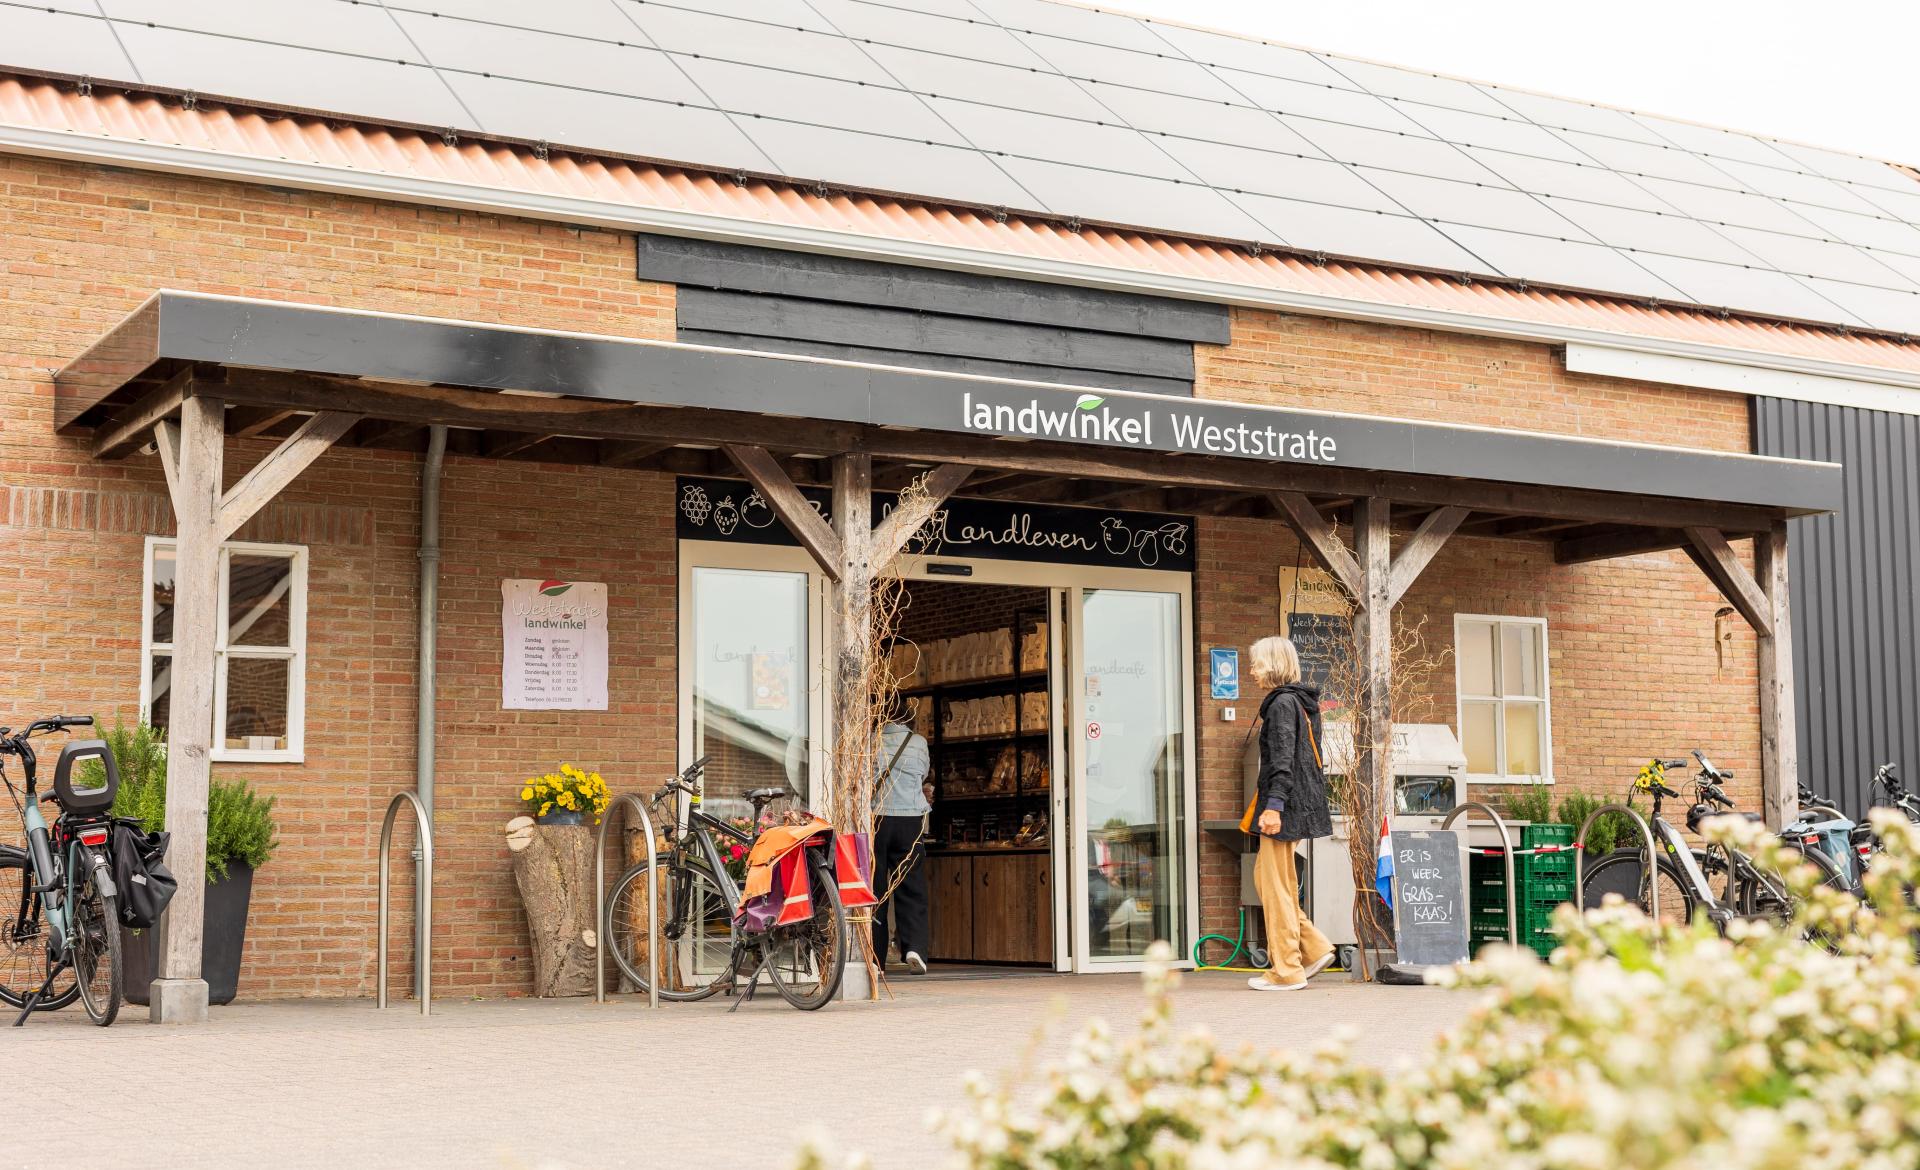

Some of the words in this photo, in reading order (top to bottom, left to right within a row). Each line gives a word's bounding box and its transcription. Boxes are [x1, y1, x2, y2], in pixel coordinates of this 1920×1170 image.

[963, 393, 1152, 445] landwinkel
[1171, 413, 1337, 462] Weststrate
[942, 509, 1097, 551] Landleven
[524, 618, 587, 630] landwinkel
[1400, 849, 1415, 863] ER
[1411, 867, 1443, 880] WEER
[1413, 900, 1453, 922] KAAS!
